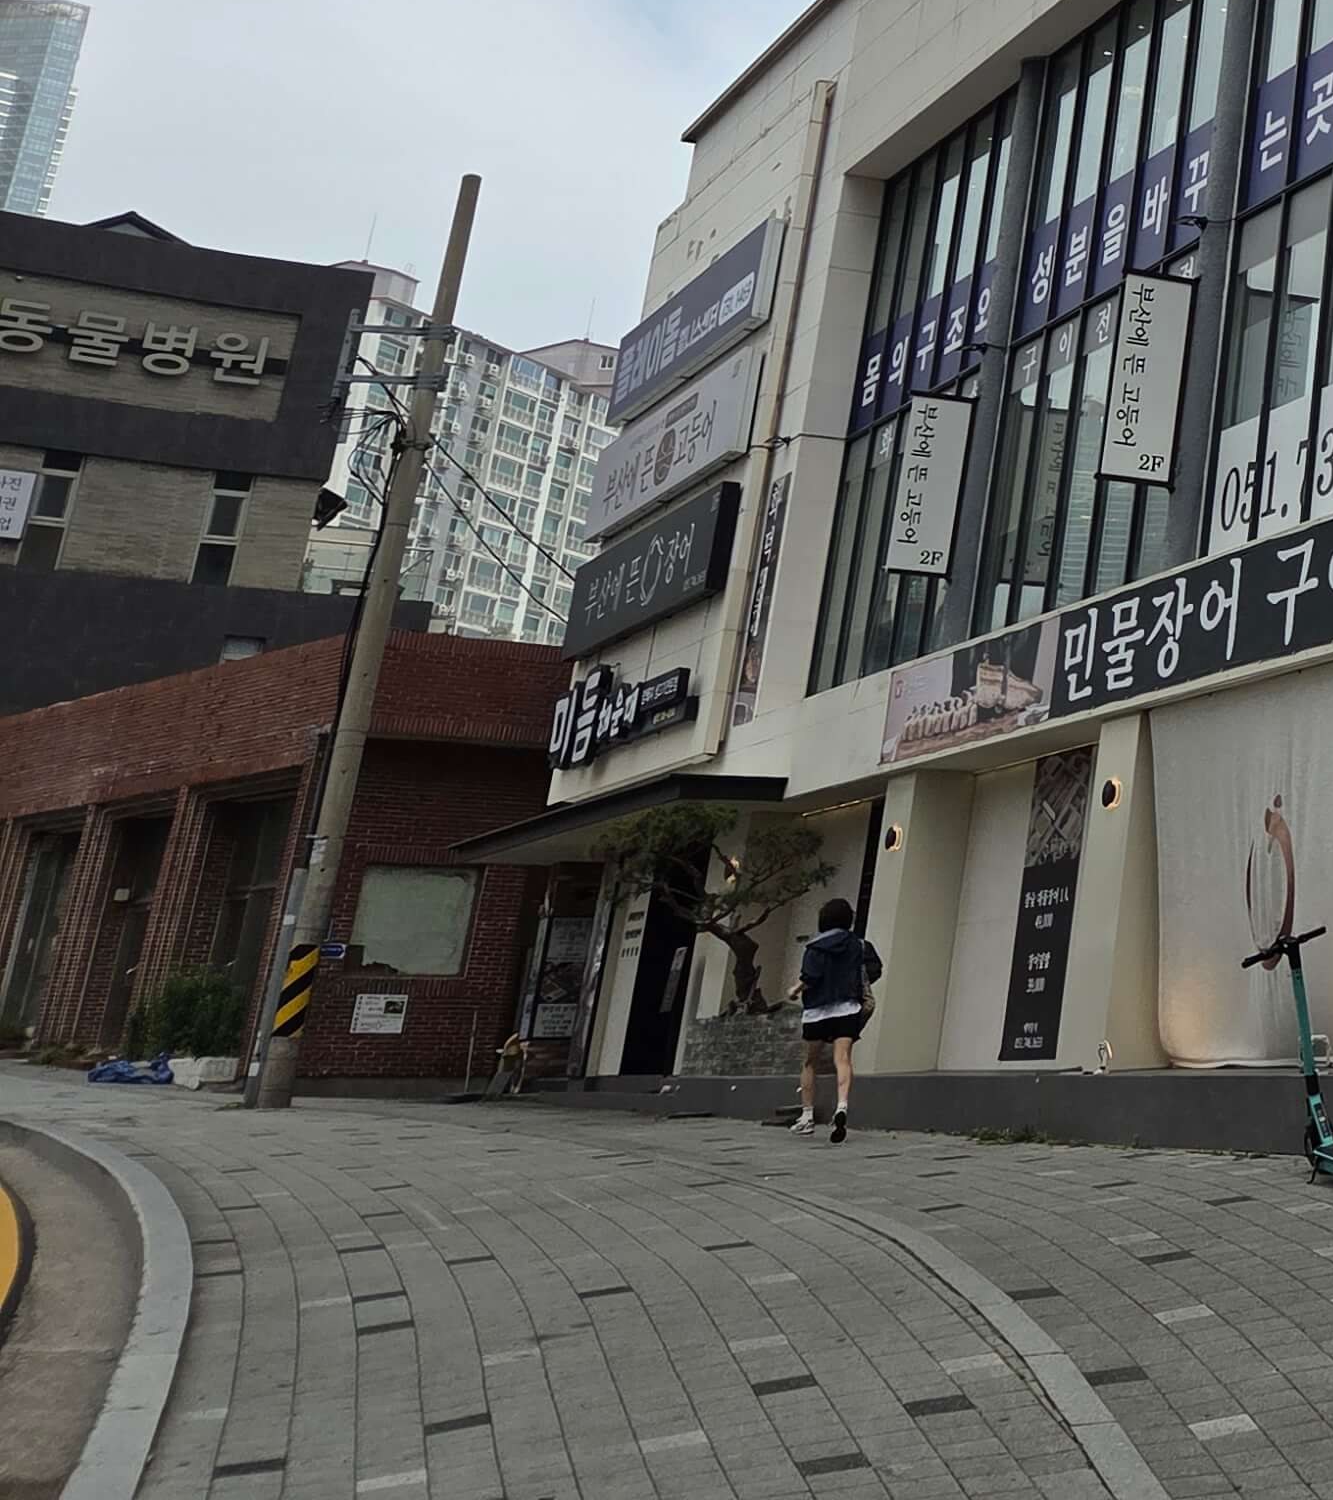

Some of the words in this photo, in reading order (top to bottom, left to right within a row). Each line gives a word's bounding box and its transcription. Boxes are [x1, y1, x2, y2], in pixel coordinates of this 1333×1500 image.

[1032, 202, 1125, 304] 성분을
[0, 299, 268, 387] 동물병원
[1126, 283, 1155, 346] 부산에
[911, 403, 938, 458] 부산에
[1113, 383, 1137, 448] 고등어
[603, 452, 641, 516] 부산에
[673, 400, 717, 463] 고등어
[1139, 455, 1165, 471] 2F
[897, 489, 922, 545] 고등어
[664, 523, 695, 584] 장어
[920, 551, 943, 566] 2F
[1065, 557, 1238, 701] 민물장어
[549, 671, 601, 764] 미듬
